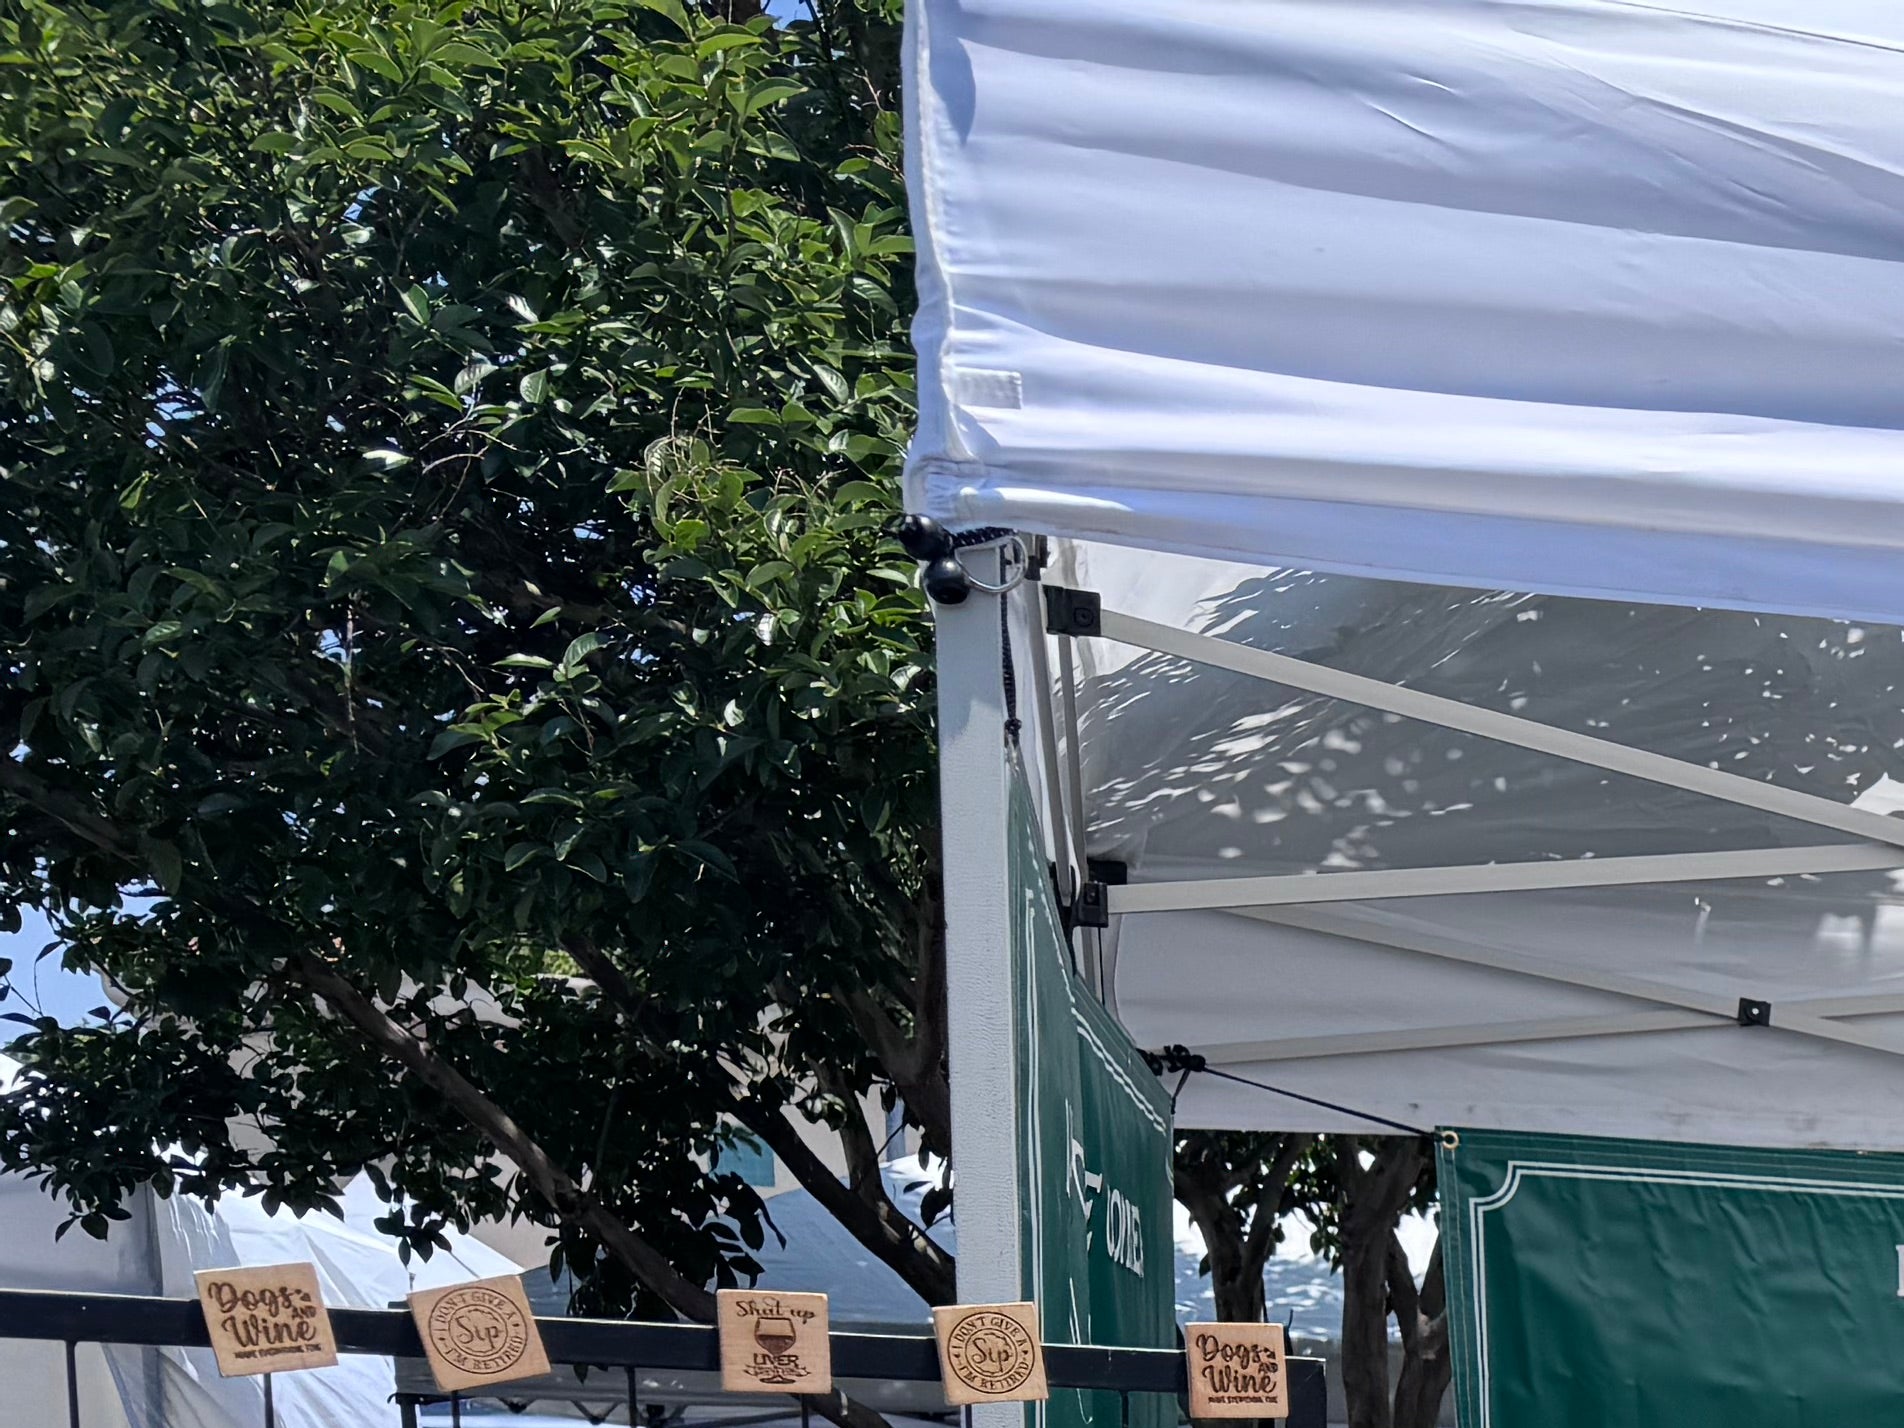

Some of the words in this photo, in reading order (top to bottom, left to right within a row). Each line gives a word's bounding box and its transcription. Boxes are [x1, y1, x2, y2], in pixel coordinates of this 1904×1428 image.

[208, 1282, 293, 1317] Dogs
[221, 1314, 317, 1347] Wine
[971, 1337, 1011, 1373] Sip
[1196, 1334, 1261, 1370] Dogs
[1202, 1365, 1277, 1393] Wine
